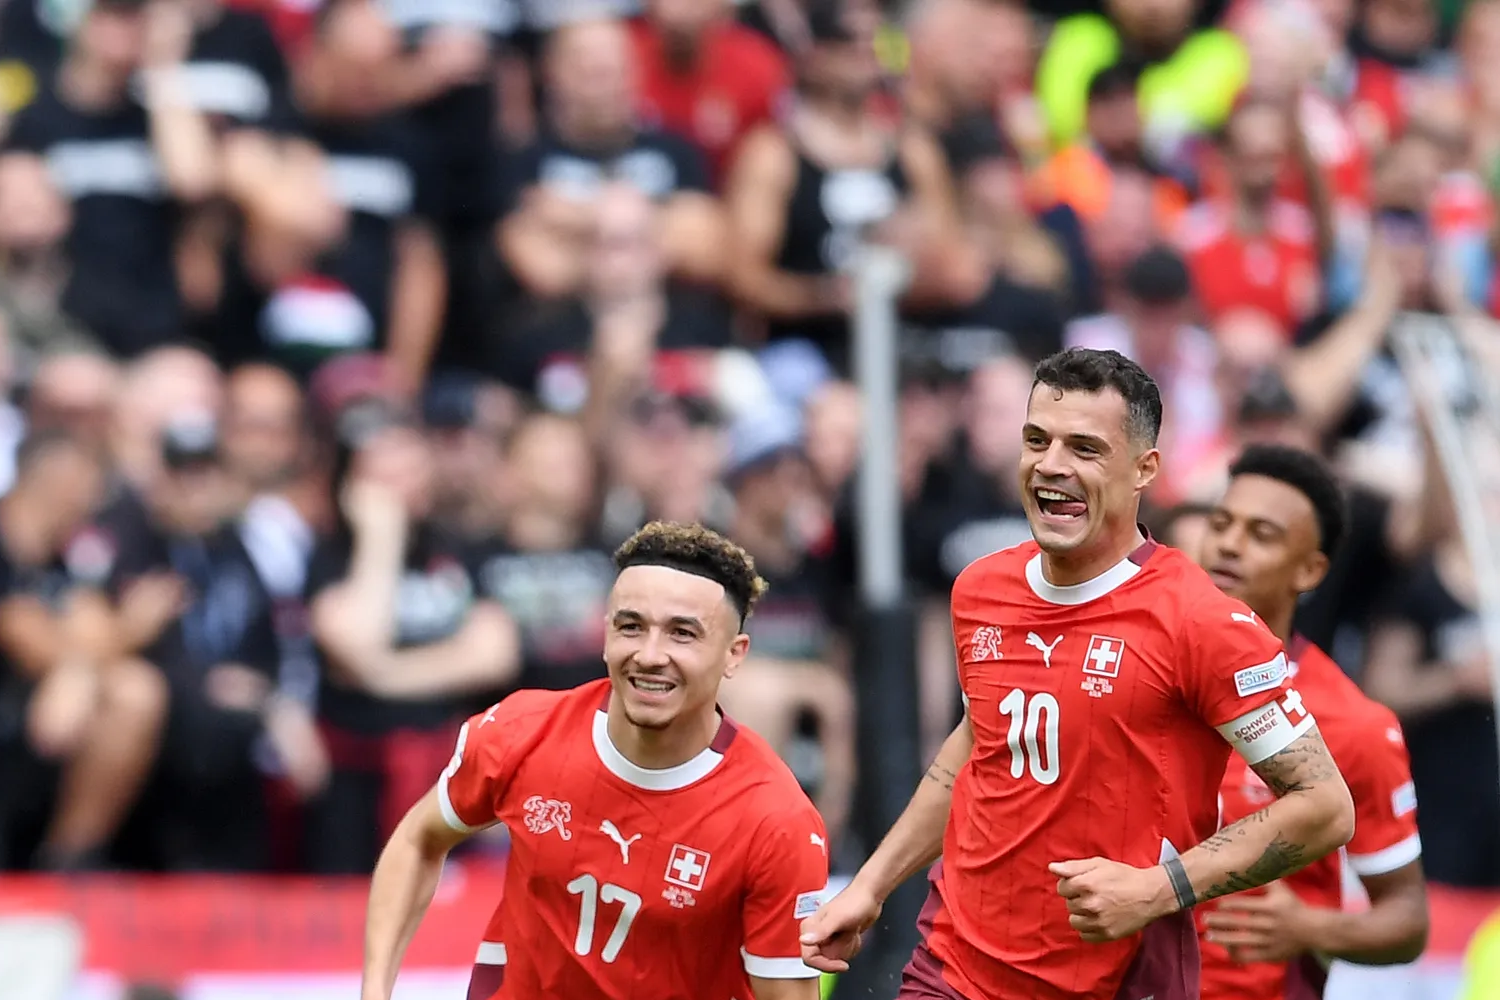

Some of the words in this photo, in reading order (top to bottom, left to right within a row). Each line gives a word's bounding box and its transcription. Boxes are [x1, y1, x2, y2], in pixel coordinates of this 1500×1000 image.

[999, 688, 1060, 785] 10
[1234, 707, 1277, 738] SCHWEIZ
[1243, 718, 1278, 743] SUISSE
[567, 874, 642, 963] 17
